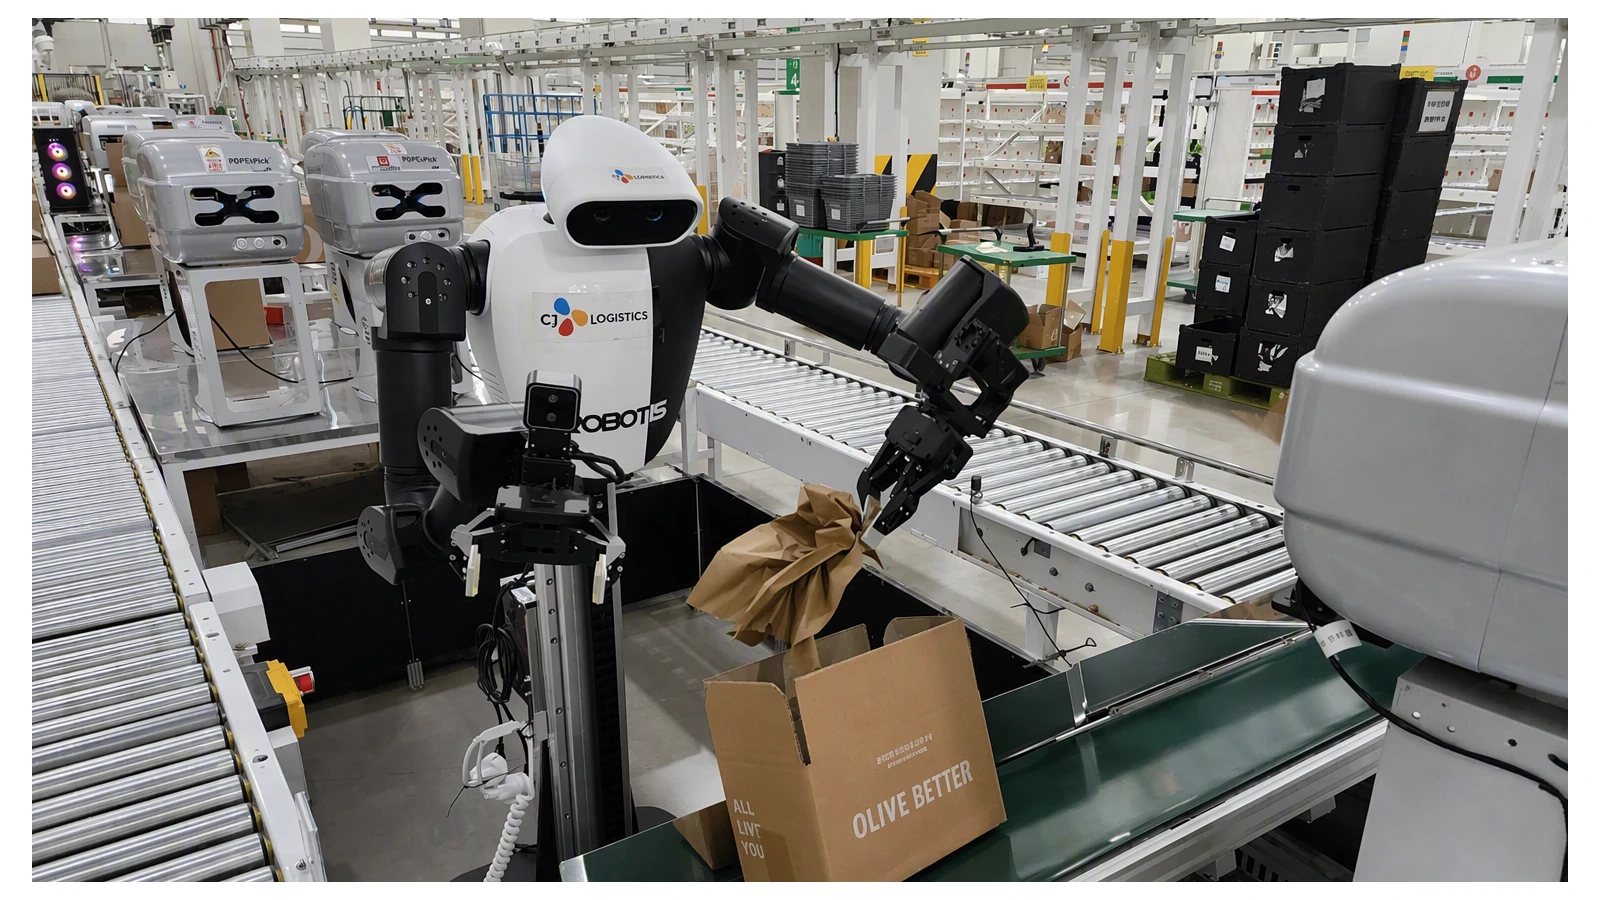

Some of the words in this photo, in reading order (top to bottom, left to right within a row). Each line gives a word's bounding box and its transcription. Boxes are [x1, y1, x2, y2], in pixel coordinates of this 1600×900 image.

[540, 313, 558, 328] CJ
[590, 311, 648, 325] LOGISTICS
[733, 799, 755, 817] ALL
[852, 790, 910, 839] OLIVE
[911, 759, 974, 810] BETTER
[737, 819, 761, 839] LIVE
[741, 840, 765, 859] YOU
